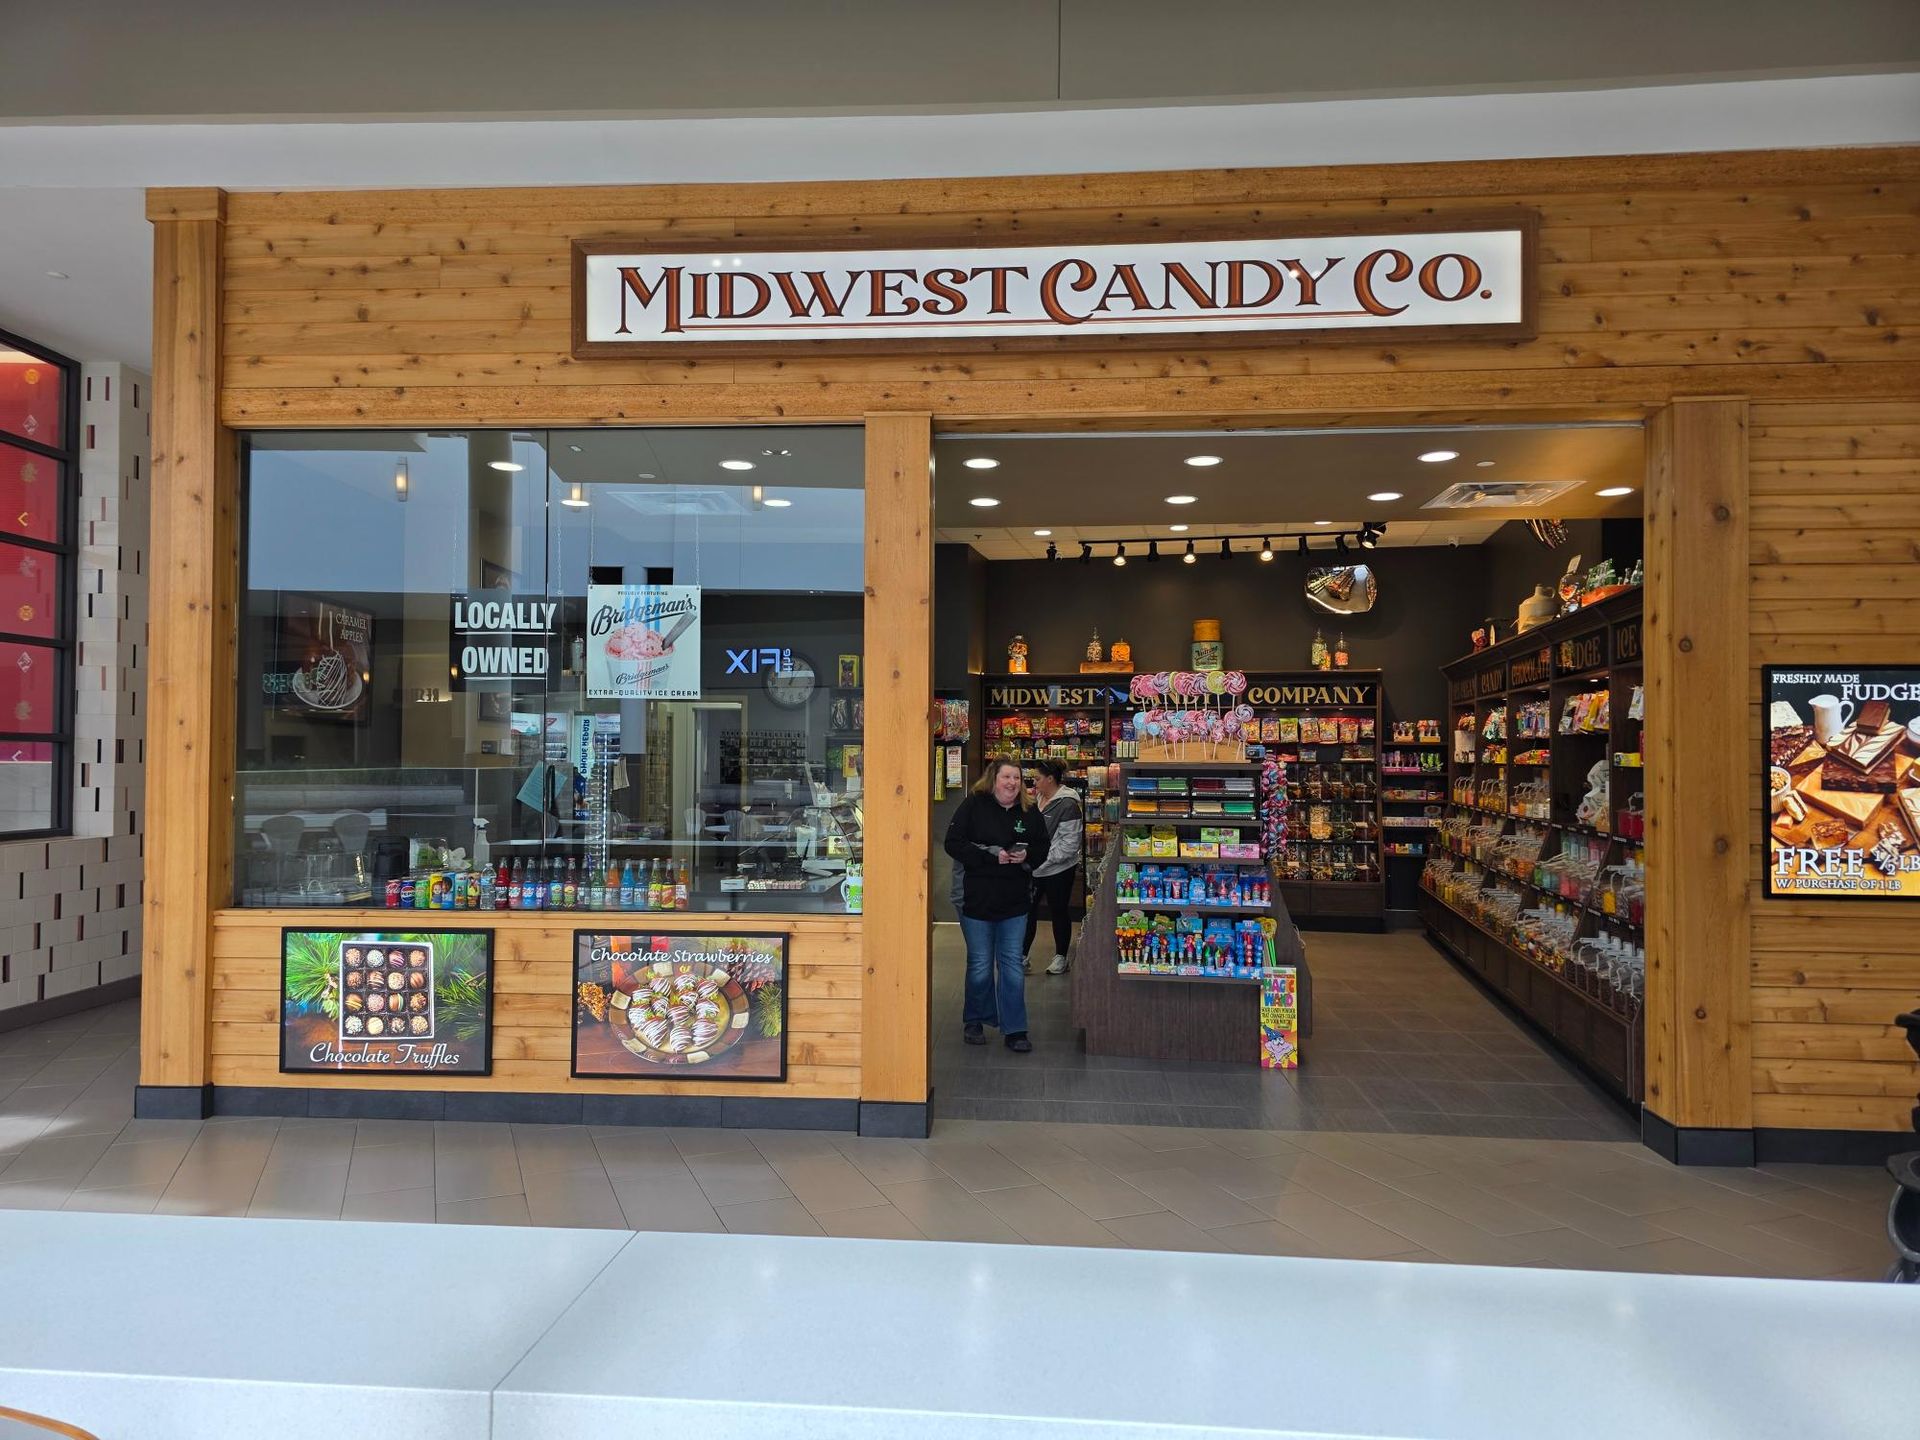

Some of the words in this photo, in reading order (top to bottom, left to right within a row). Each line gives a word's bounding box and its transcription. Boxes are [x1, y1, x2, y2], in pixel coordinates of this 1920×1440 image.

[615, 266, 1029, 334] MIDWEST
[1039, 257, 1345, 325] CANDY
[1353, 248, 1493, 317] CO.
[454, 602, 557, 630] LOCALLY
[590, 594, 697, 636] Bridgeman's
[461, 646, 549, 675] OWNED
[1772, 673, 1823, 685] FRESHLY
[1824, 674, 1860, 684] MADE
[991, 688, 1097, 705] MIDWEST
[1248, 686, 1370, 704] COMPANY
[1841, 683, 1920, 702] FUDGE
[1775, 847, 1865, 879] FREE
[1898, 854, 1920, 873] LB
[1775, 878, 1793, 890] W/
[1795, 879, 1857, 890] PURCHASE
[1859, 879, 1877, 890] OF
[1879, 880, 1885, 889] 1
[1887, 880, 1901, 890] LB
[591, 948, 670, 963] Chocolate
[672, 949, 774, 964] Strawberries
[1263, 978, 1295, 993] MAGIC
[1264, 993, 1294, 1007] WAND
[310, 1043, 391, 1065] Chocolate
[396, 1044, 460, 1070] Truffles
